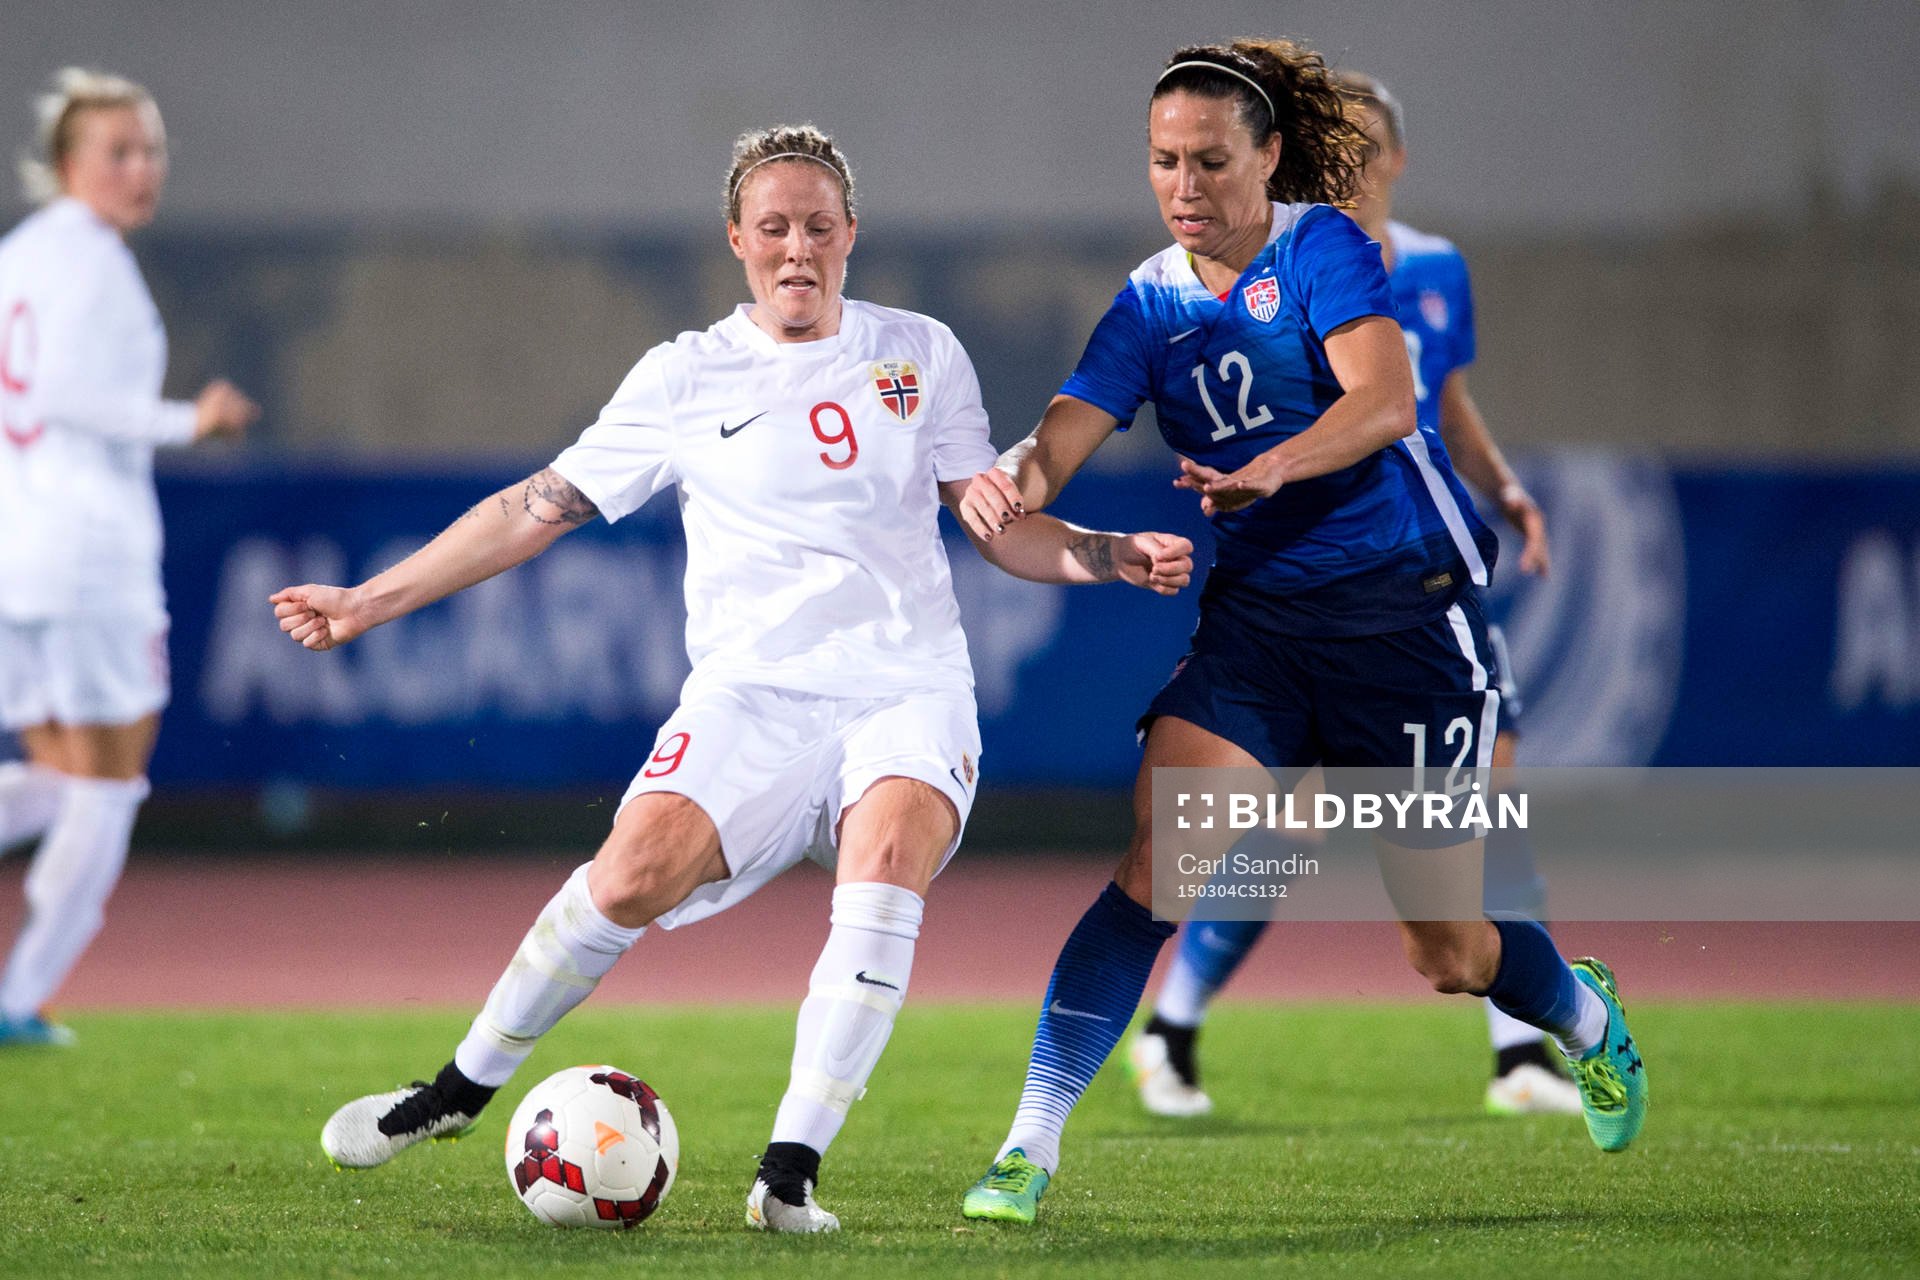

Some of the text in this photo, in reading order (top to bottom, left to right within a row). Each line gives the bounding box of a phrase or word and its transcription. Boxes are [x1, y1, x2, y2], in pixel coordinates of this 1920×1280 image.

[1191, 350, 1275, 442] 12
[809, 401, 859, 470] 9
[644, 732, 691, 778] 9
[1400, 716, 1474, 801] 12
